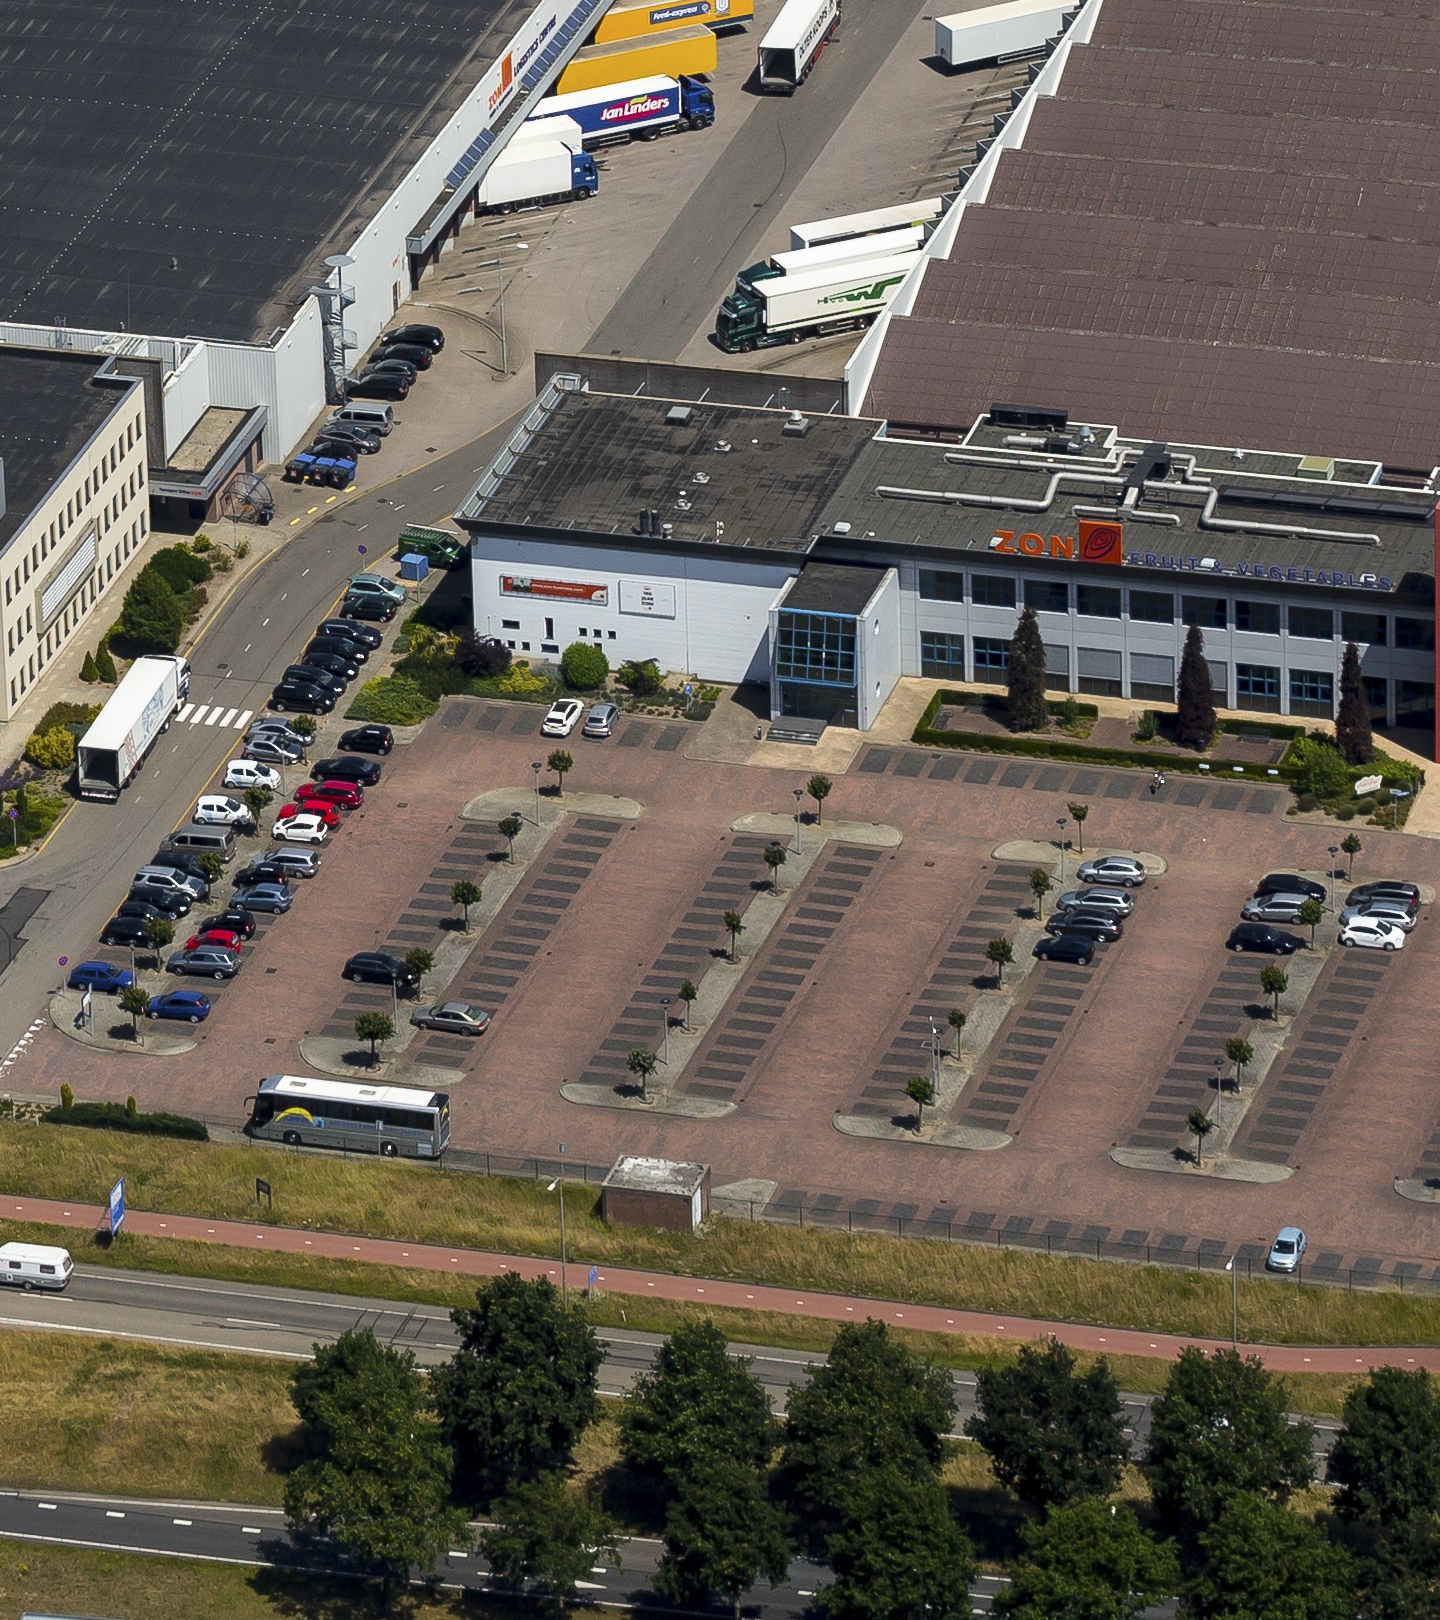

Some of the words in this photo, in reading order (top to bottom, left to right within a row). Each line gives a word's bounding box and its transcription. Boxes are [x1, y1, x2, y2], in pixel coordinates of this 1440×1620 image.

[513, 37, 539, 78] LOGISTICS
[600, 108, 621, 121] Jan
[623, 97, 670, 117] Linders
[994, 529, 1073, 560] ZON
[1130, 551, 1199, 571] FRUIT
[1211, 560, 1223, 574] &
[1237, 563, 1392, 591] VEGETABLES
